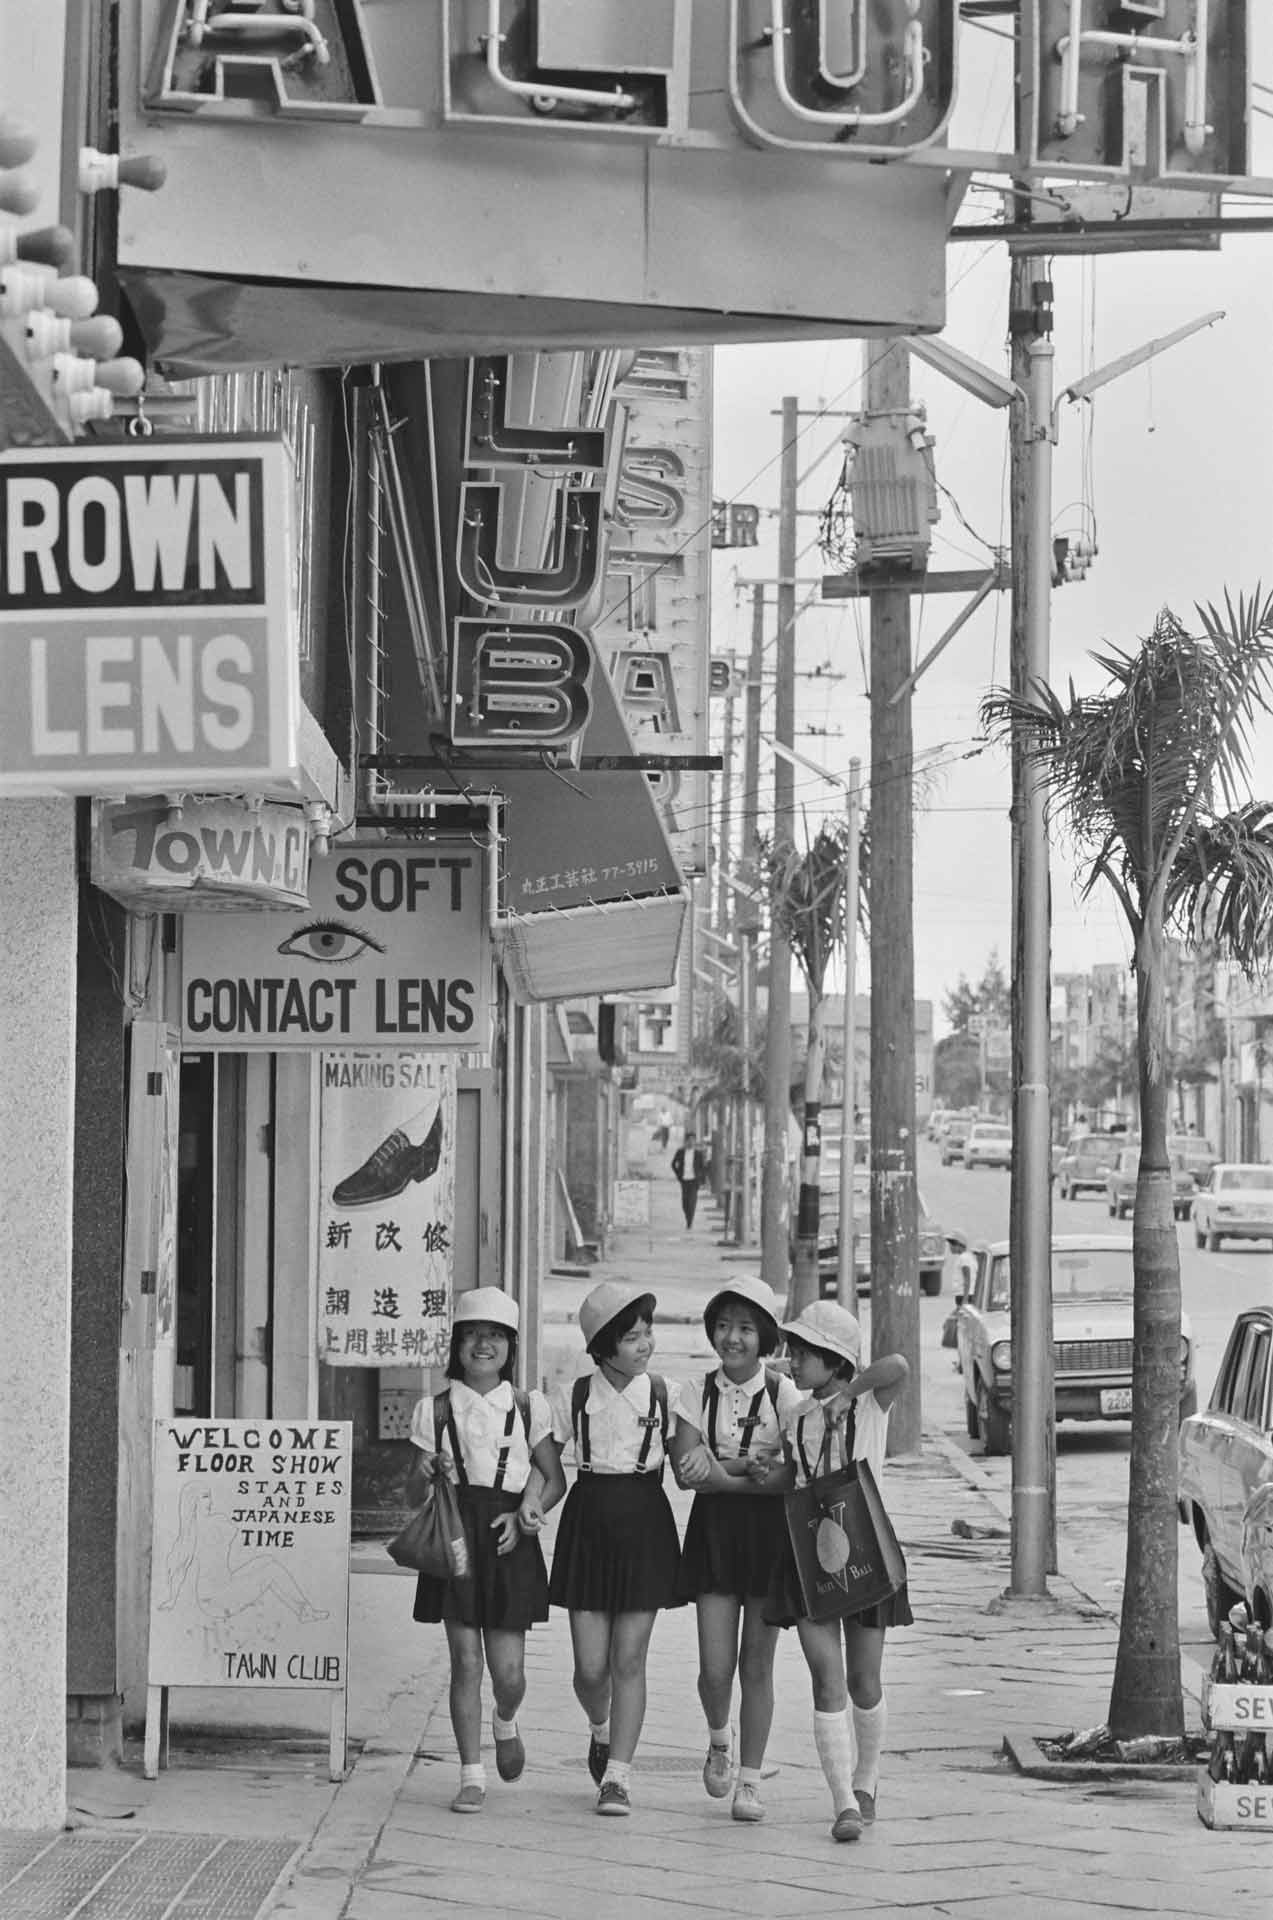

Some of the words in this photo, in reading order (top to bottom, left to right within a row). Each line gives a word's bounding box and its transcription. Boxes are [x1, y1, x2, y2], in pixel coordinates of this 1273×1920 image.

[7, 473, 252, 595] ROWN
[30, 634, 255, 756] LENS
[335, 857, 473, 913] SOFT
[187, 978, 357, 1034] CONTACT
[375, 978, 475, 1034] LENS
[325, 1063, 395, 1089] MAKING
[168, 1427, 341, 1450] WELCOME
[177, 1452, 255, 1474] FLOOR
[271, 1454, 343, 1475] SHOW
[237, 1480, 344, 1496] STATES
[262, 1496, 306, 1508] AND
[231, 1509, 336, 1524] JAPANESE
[241, 1529, 295, 1548] TIME
[223, 1652, 277, 1680] TAWN
[287, 1654, 341, 1682] CLUB
[1237, 1796, 1273, 1819] SE
